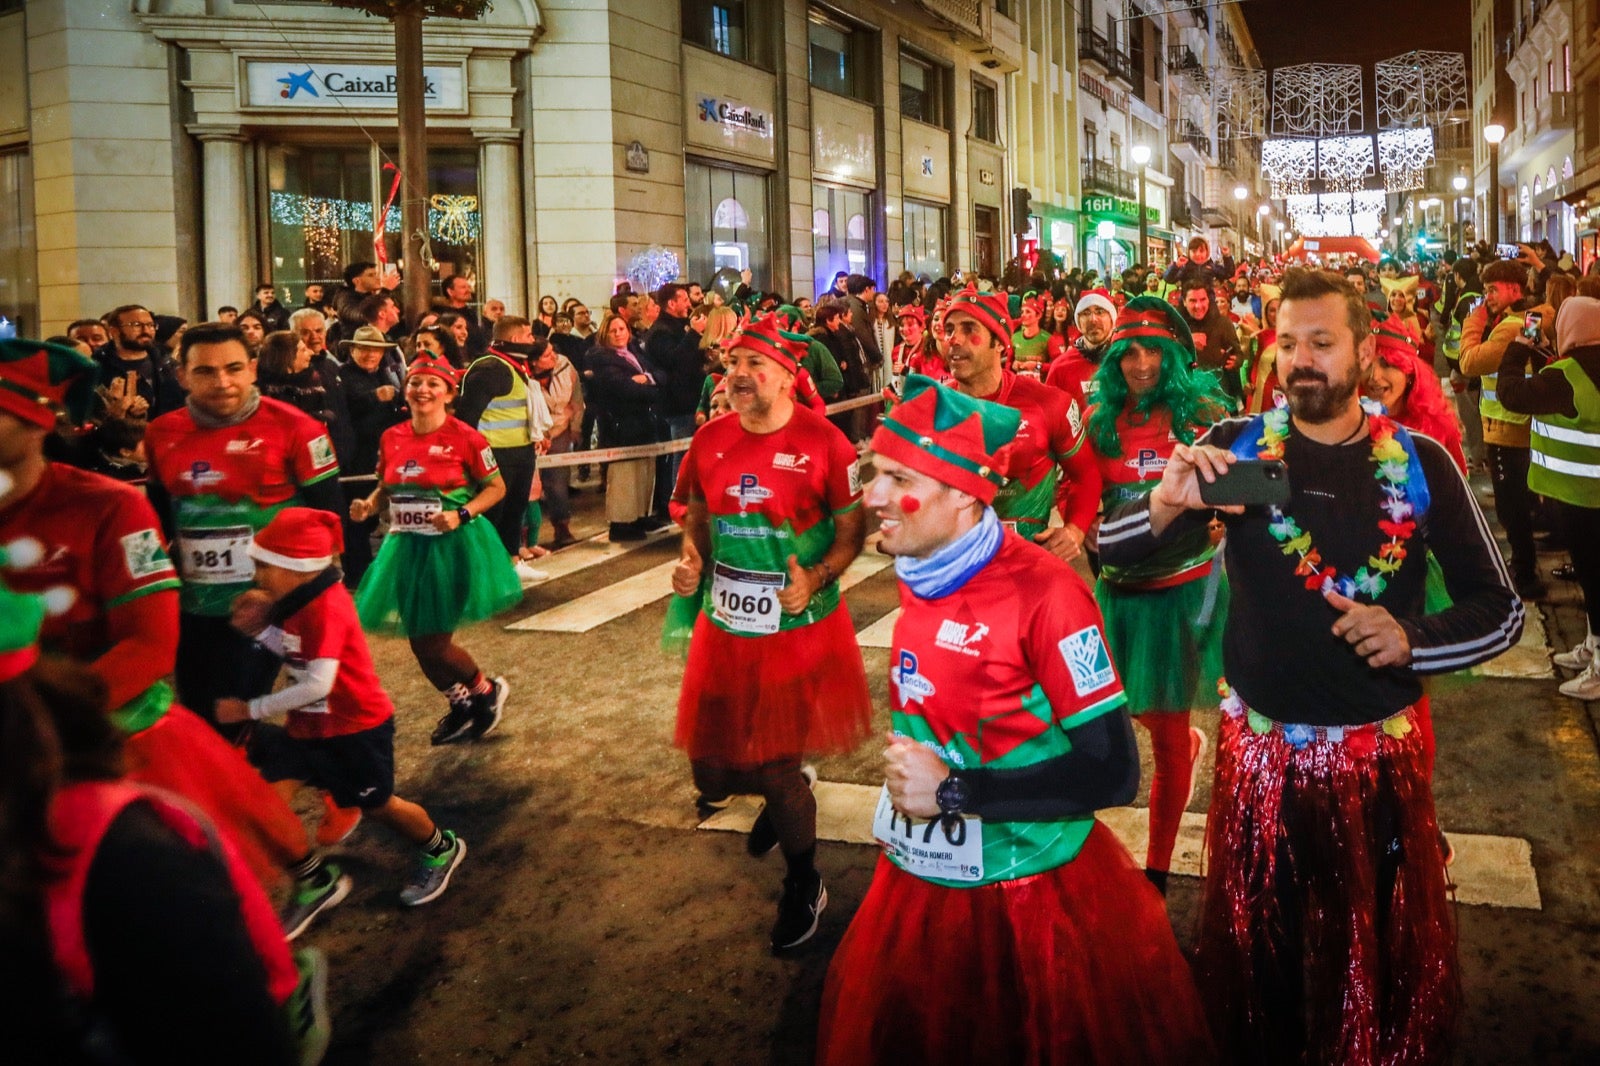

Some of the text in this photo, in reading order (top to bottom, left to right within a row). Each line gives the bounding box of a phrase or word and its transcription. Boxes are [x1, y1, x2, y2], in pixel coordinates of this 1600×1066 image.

[324, 72, 437, 95] CaixaBk
[719, 103, 766, 129] CaixaBank
[1085, 198, 1113, 212] 16H
[719, 589, 773, 615] 1060
[929, 851, 954, 861] ROMERO
